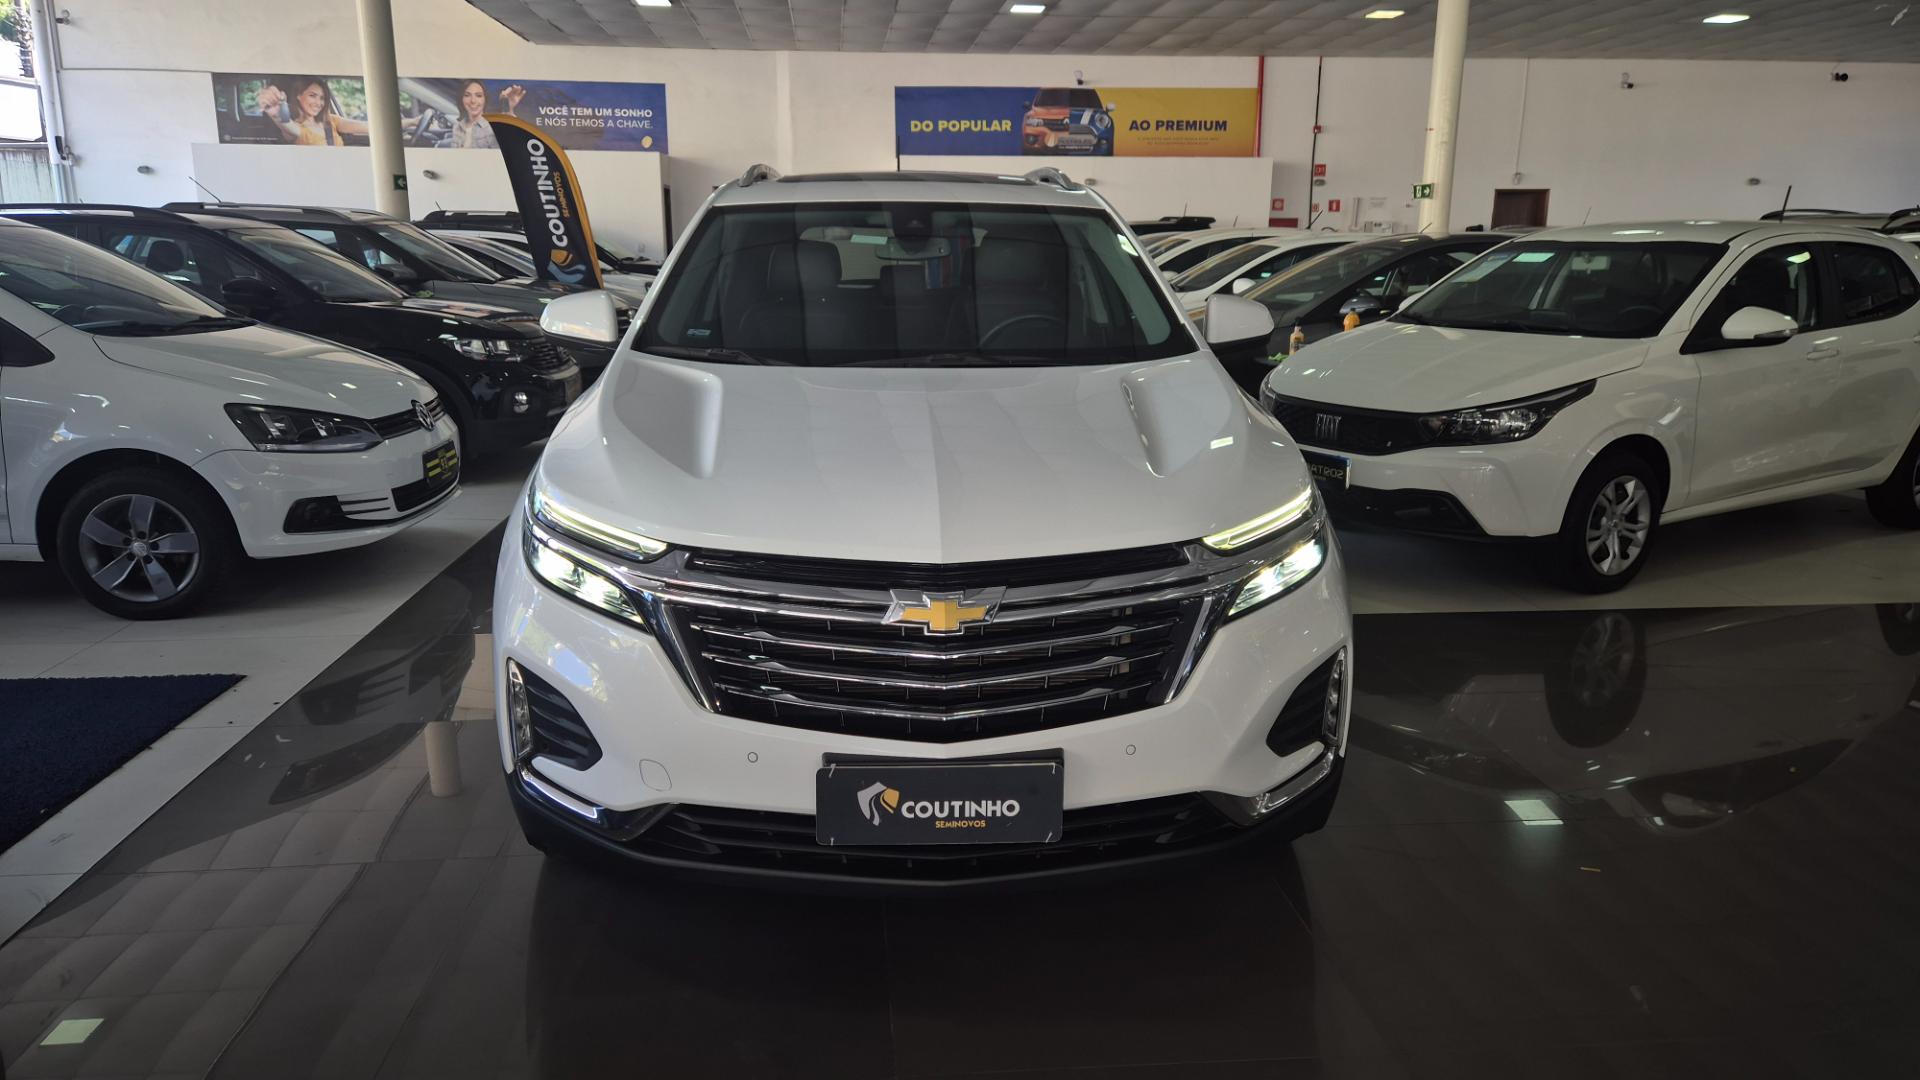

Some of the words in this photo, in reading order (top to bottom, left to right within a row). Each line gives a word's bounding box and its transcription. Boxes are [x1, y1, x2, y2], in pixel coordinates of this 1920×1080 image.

[539, 105, 568, 115] VOCÊ
[570, 107, 592, 116] TEM
[595, 108, 612, 116] UM
[614, 109, 652, 117] SONHO
[536, 117, 542, 126] E
[544, 116, 567, 127] NÓS
[569, 118, 604, 128] TEMOS
[607, 119, 614, 128] A
[616, 119, 653, 129] CHAVE.
[910, 120, 934, 132] DO
[938, 120, 1012, 132] POPULAR
[1129, 120, 1151, 131] AO
[1155, 120, 1228, 132] PREMIUM
[527, 139, 568, 247] COUTINHO
[553, 171, 569, 217] SEMINOVOS
[1316, 413, 1341, 440] FIAT
[901, 799, 1020, 819] COUTINHO
[935, 819, 986, 829] SEMINOVOS
